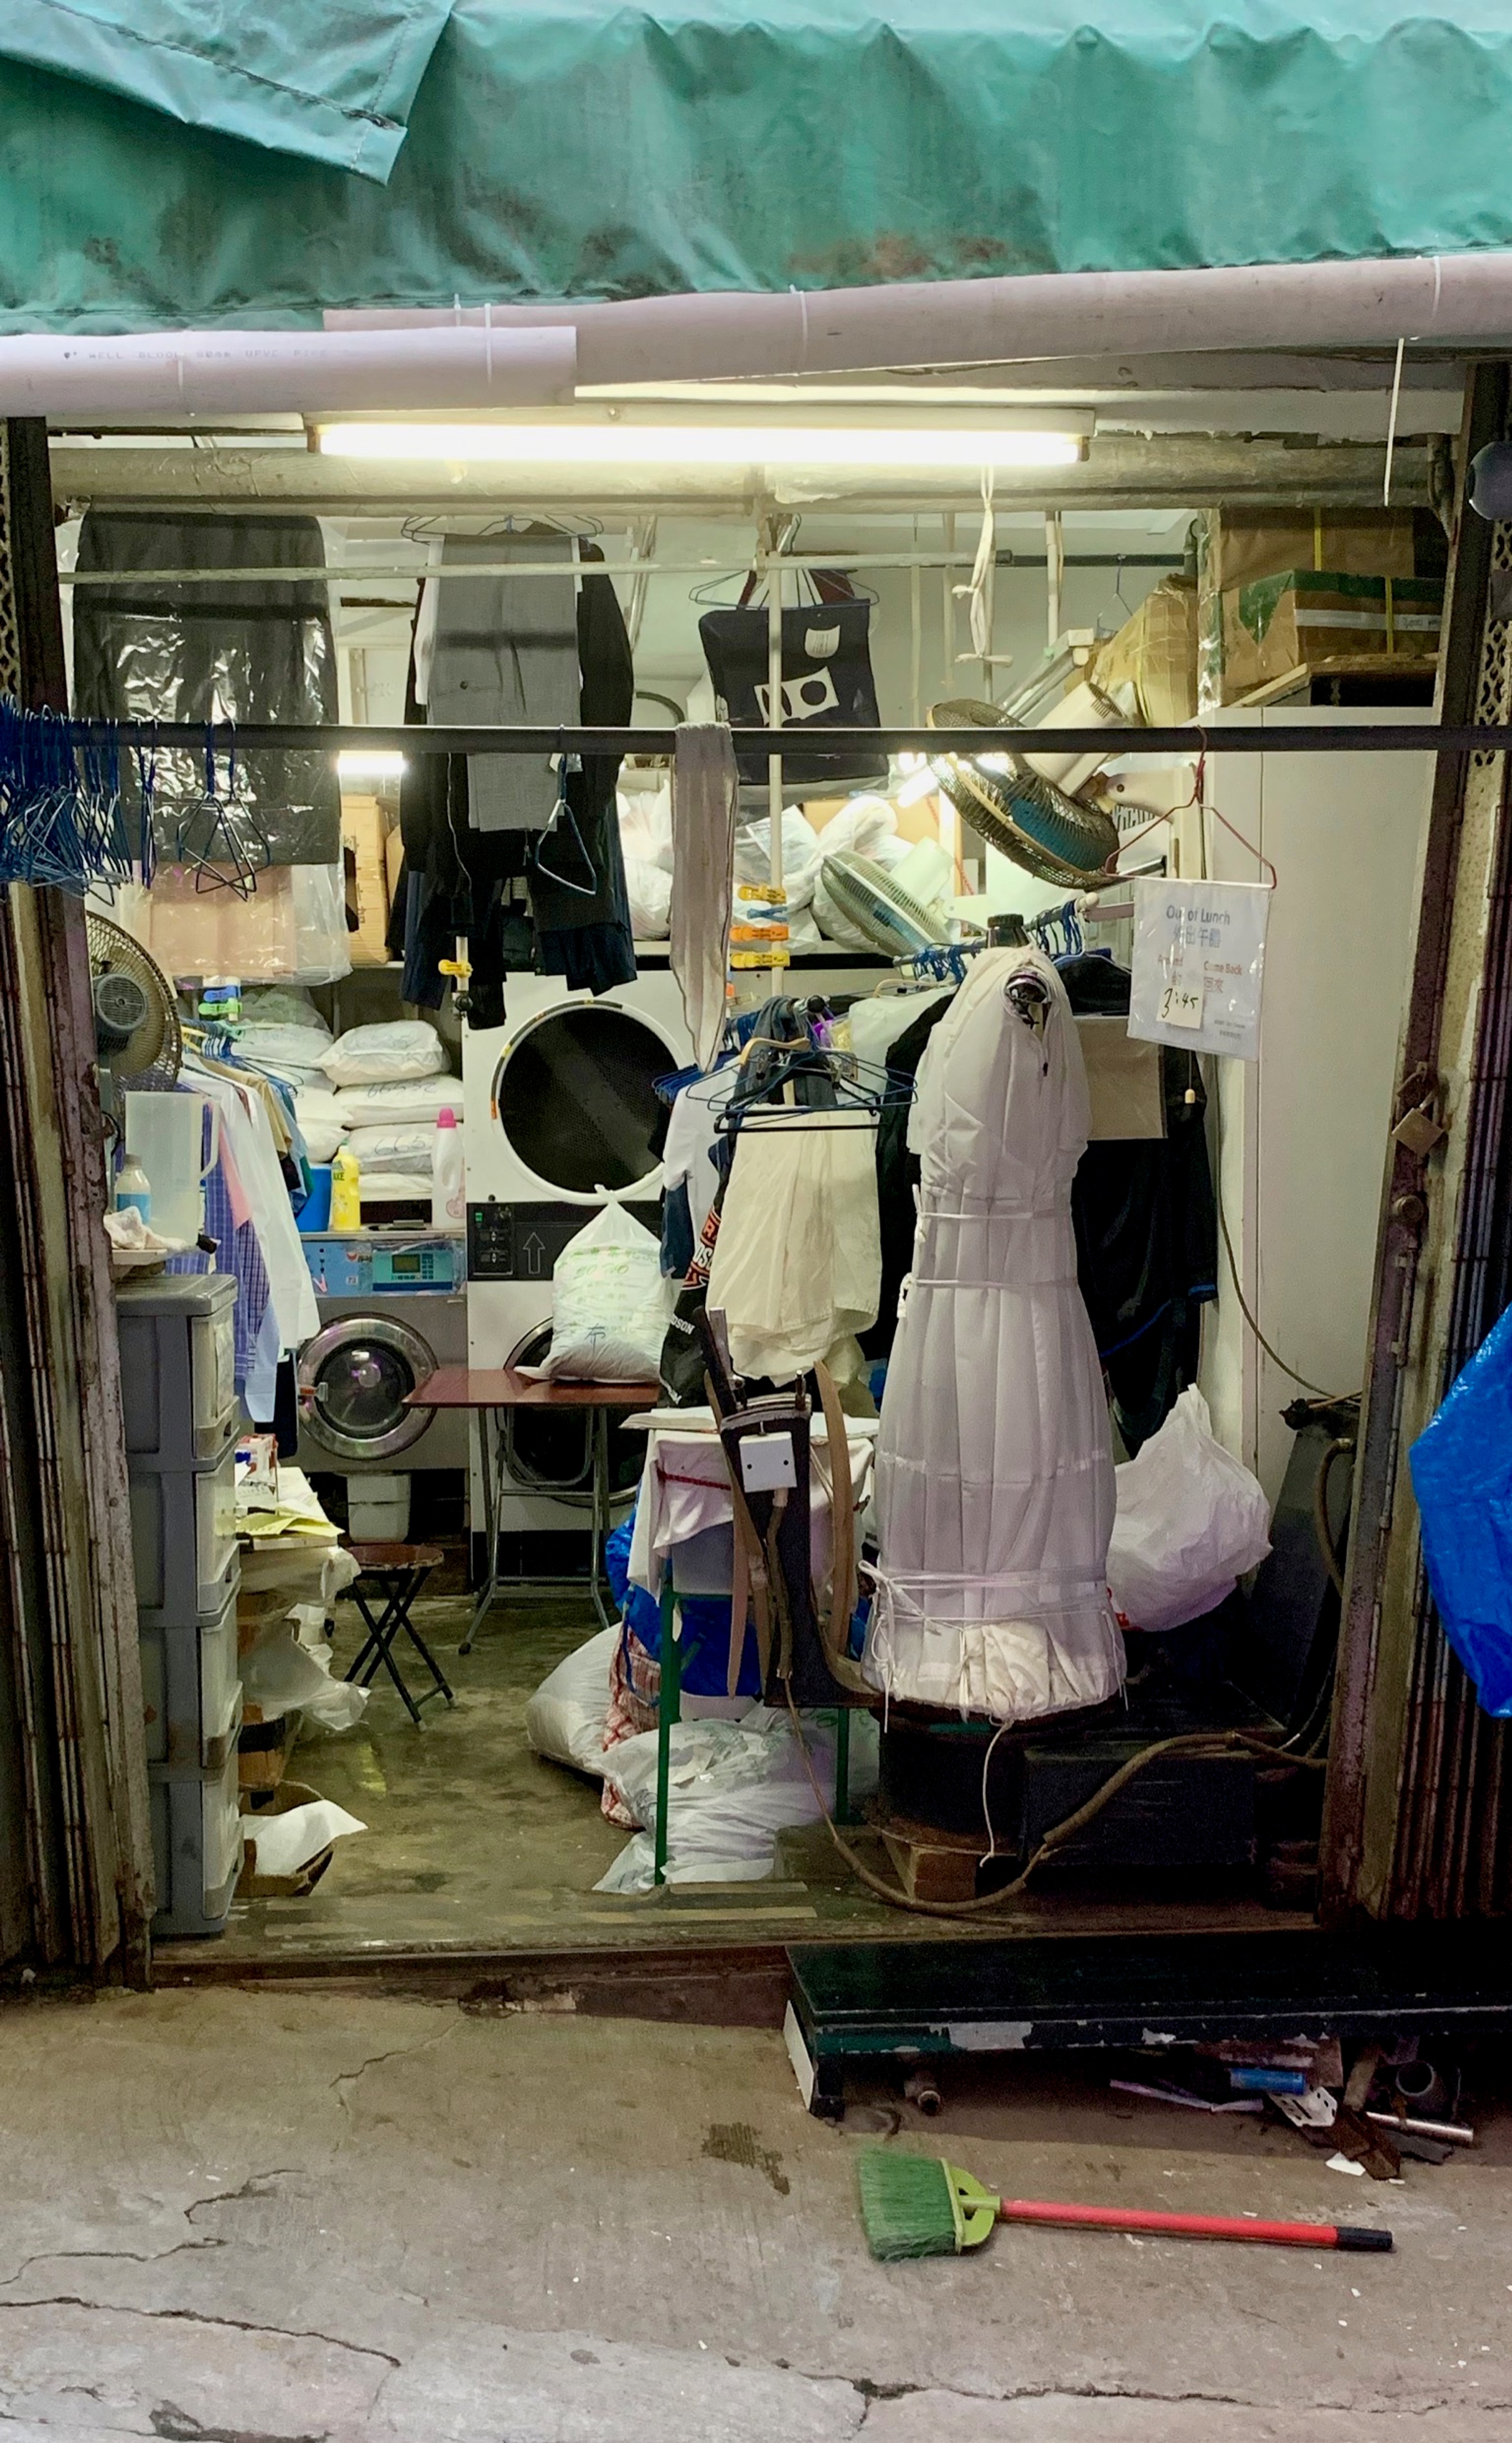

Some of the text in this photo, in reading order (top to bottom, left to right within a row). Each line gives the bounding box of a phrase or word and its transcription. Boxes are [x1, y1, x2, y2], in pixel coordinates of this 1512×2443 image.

[1166, 904, 1186, 920] Ou
[1201, 908, 1230, 926] Lunch
[1158, 953, 1184, 966] Arond
[1161, 988, 1199, 1018] 3:45
